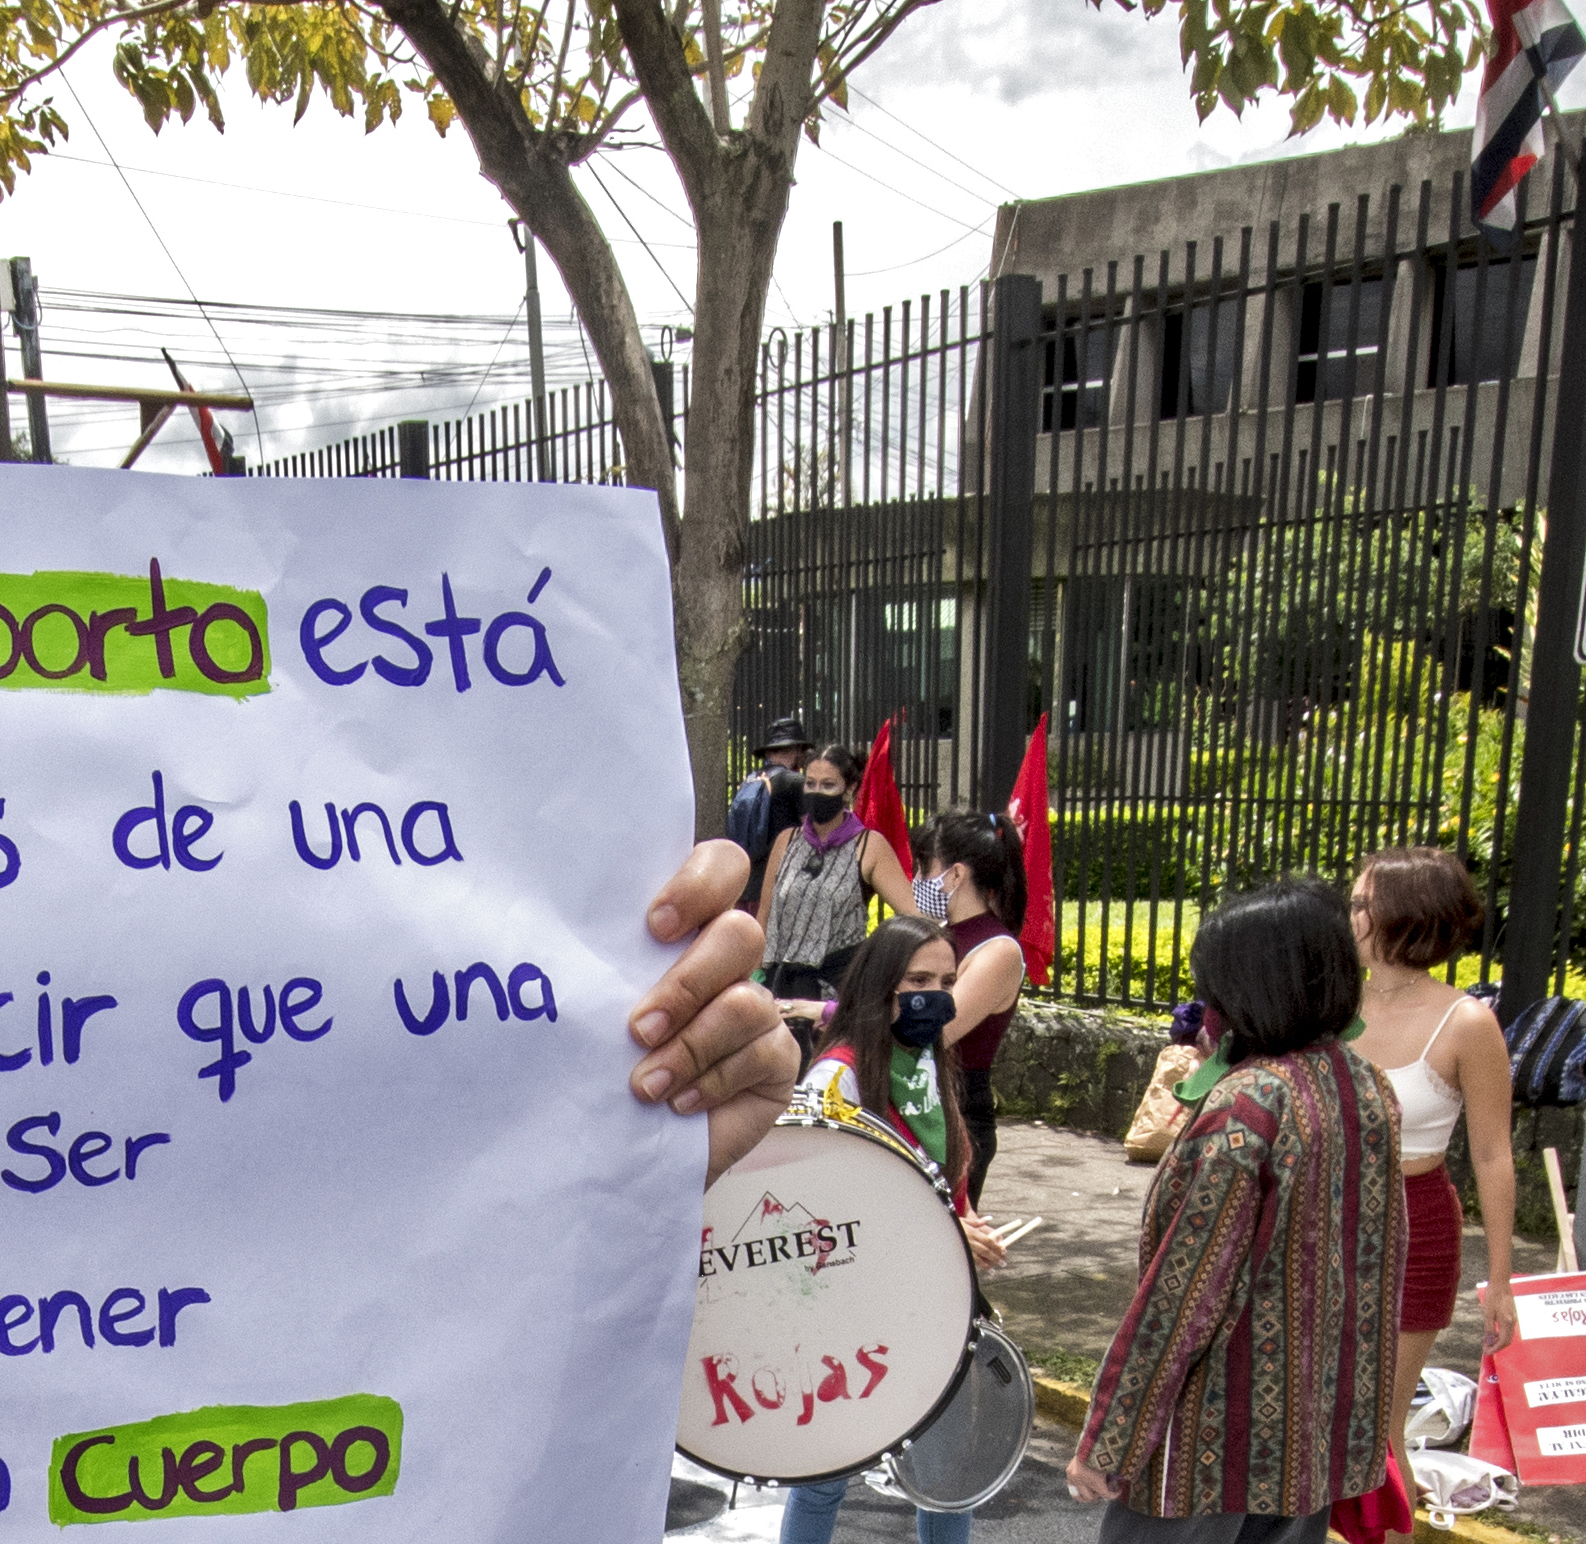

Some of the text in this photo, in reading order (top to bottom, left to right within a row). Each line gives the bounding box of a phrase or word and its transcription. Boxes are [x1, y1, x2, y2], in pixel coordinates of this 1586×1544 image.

[300, 570, 565, 693] está
[113, 770, 222, 871] de
[291, 800, 463, 868] una
[177, 976, 333, 1103] que
[394, 961, 557, 1036] una
[698, 1220, 861, 1278] EVEREST
